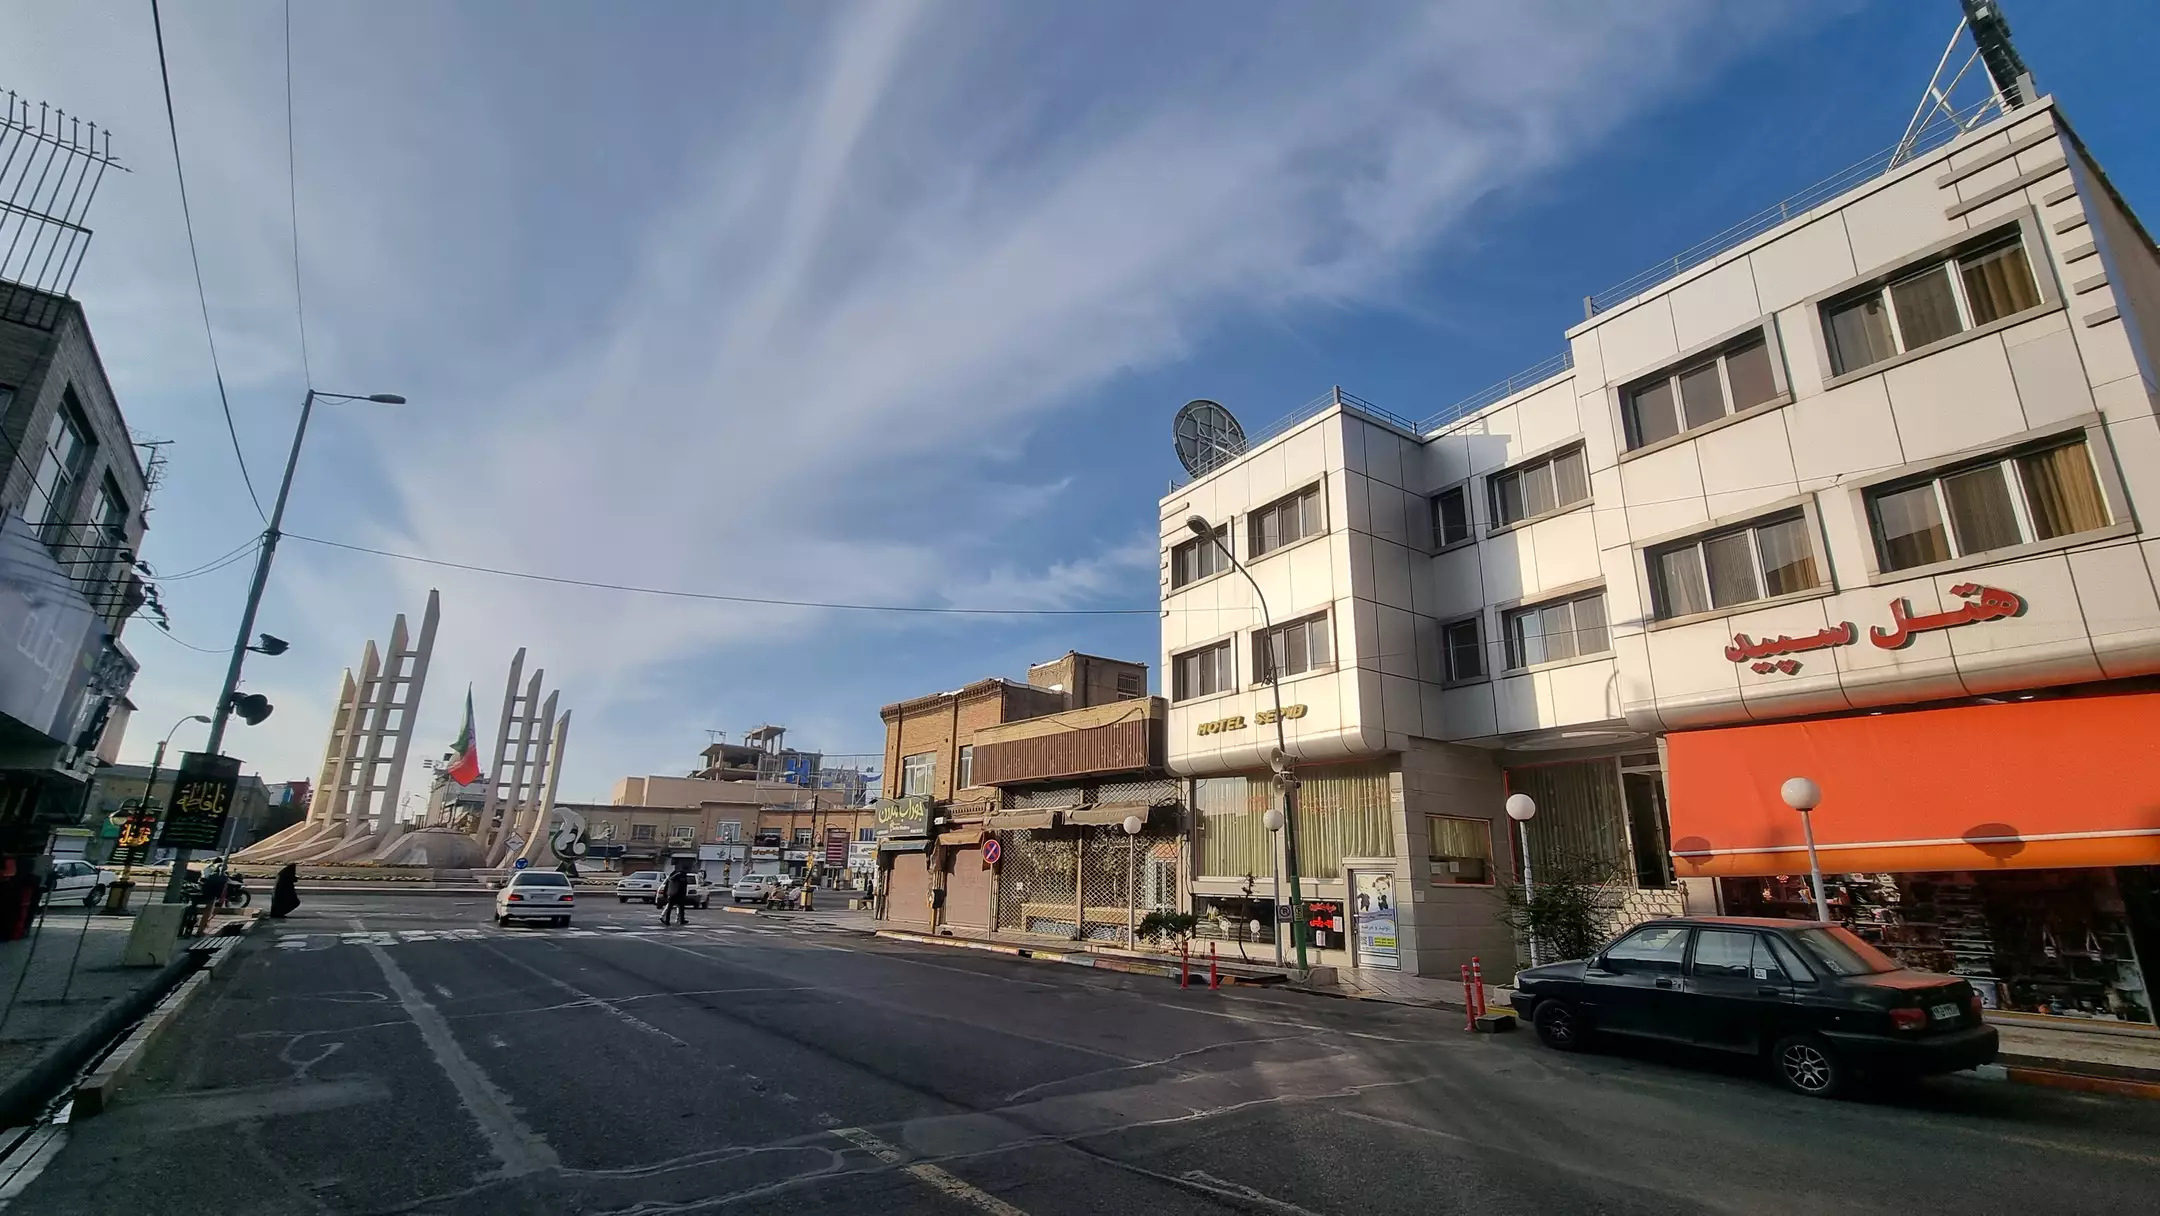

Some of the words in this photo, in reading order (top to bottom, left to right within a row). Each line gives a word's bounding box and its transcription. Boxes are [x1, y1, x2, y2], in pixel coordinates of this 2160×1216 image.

[1869, 582, 2025, 651] هتل
[1724, 620, 1857, 675] سپید
[1196, 715, 1248, 736] HOTEL
